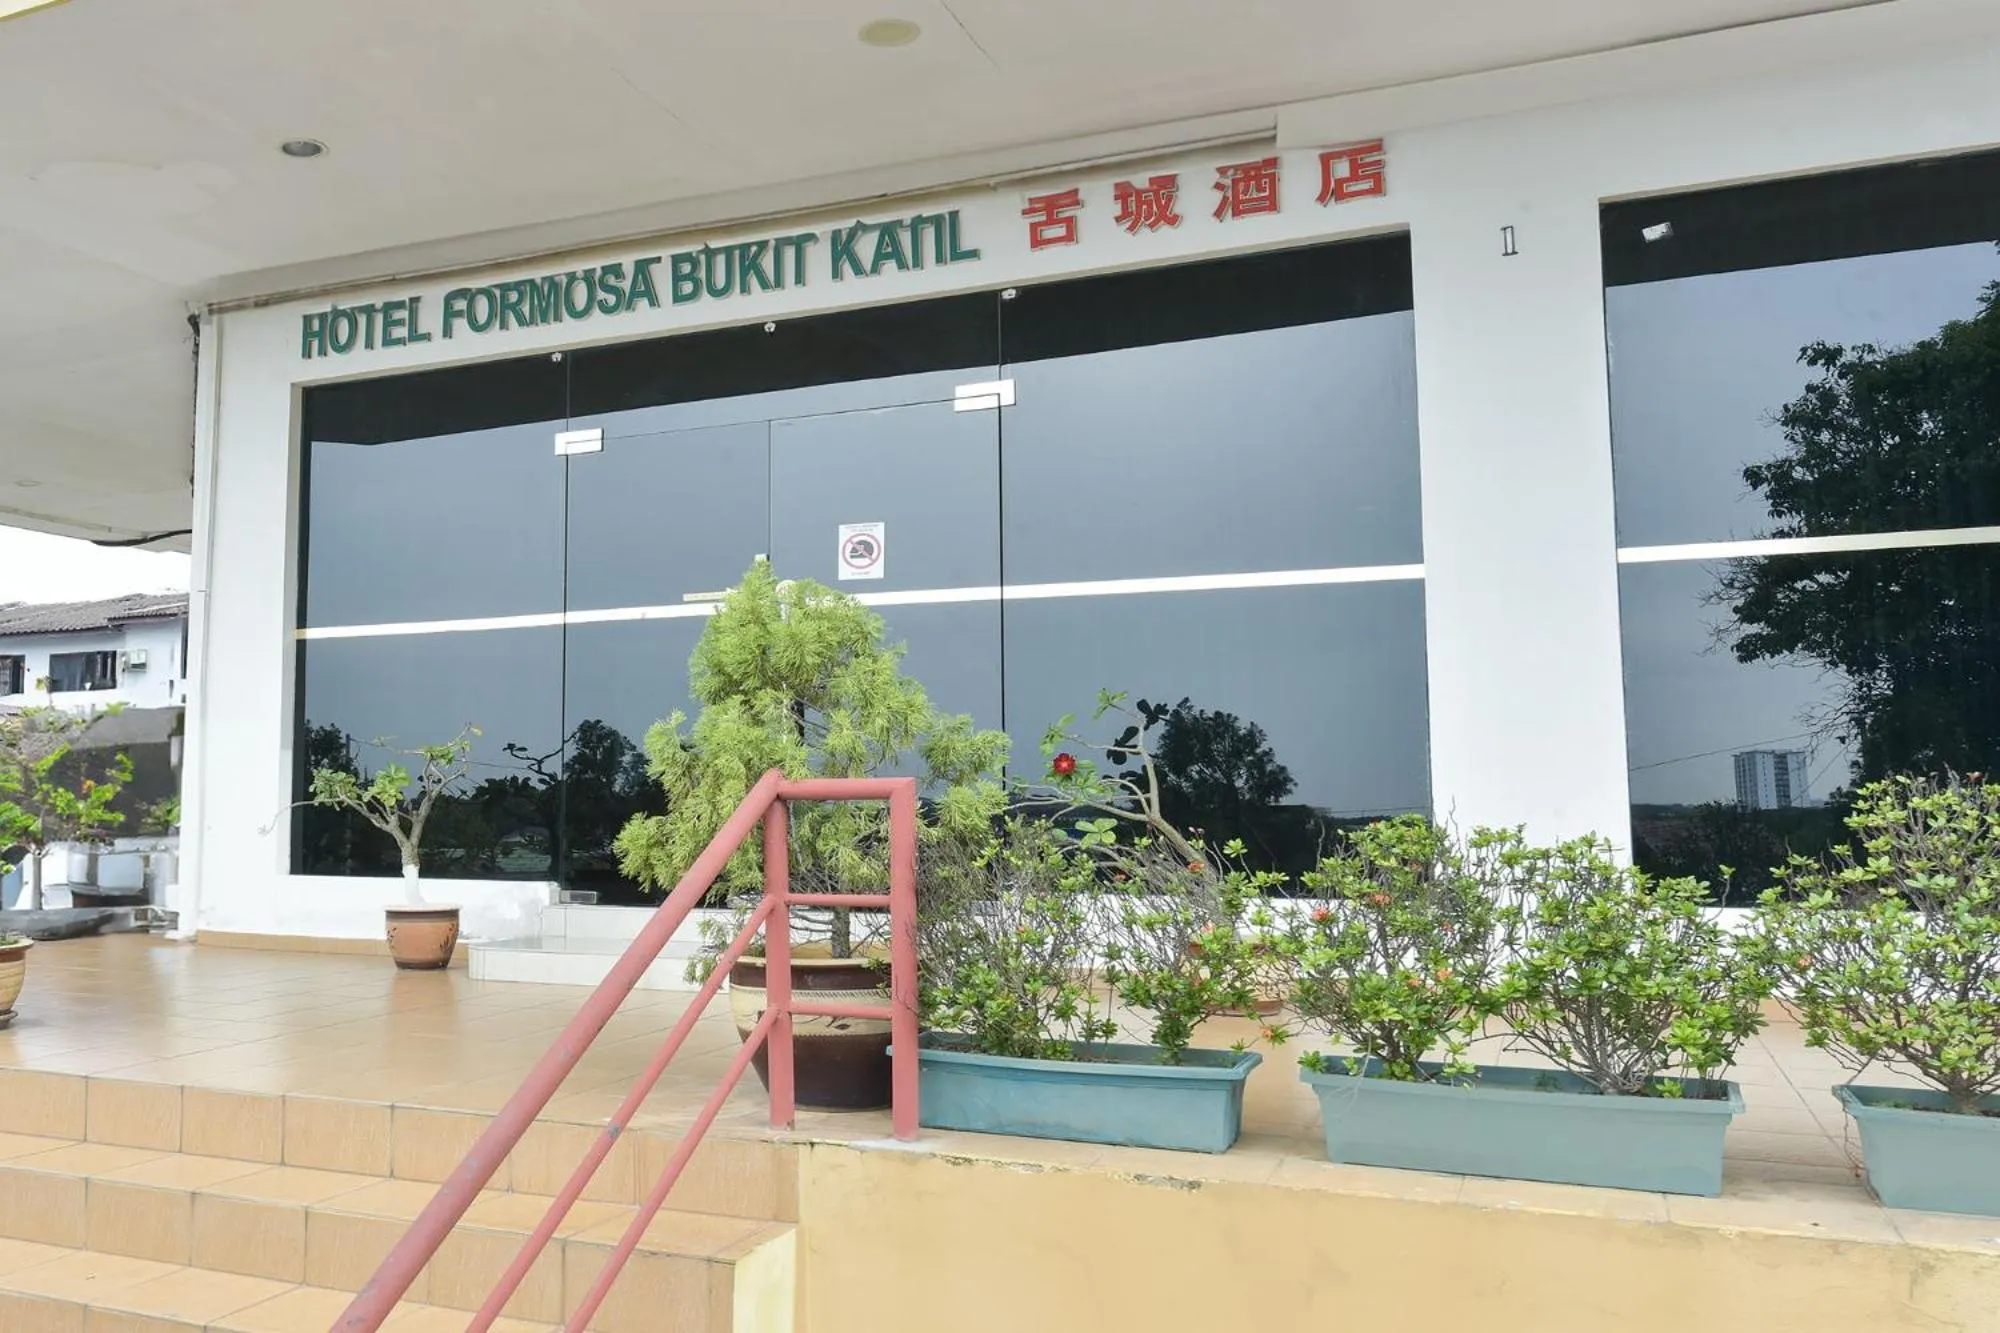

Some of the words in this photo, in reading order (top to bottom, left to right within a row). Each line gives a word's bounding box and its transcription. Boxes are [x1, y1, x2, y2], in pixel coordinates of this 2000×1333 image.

[301, 297, 432, 360] HOTEL
[441, 256, 662, 340] FORMOSA
[671, 233, 819, 308] BUKIT
[831, 209, 981, 282] KATIL
